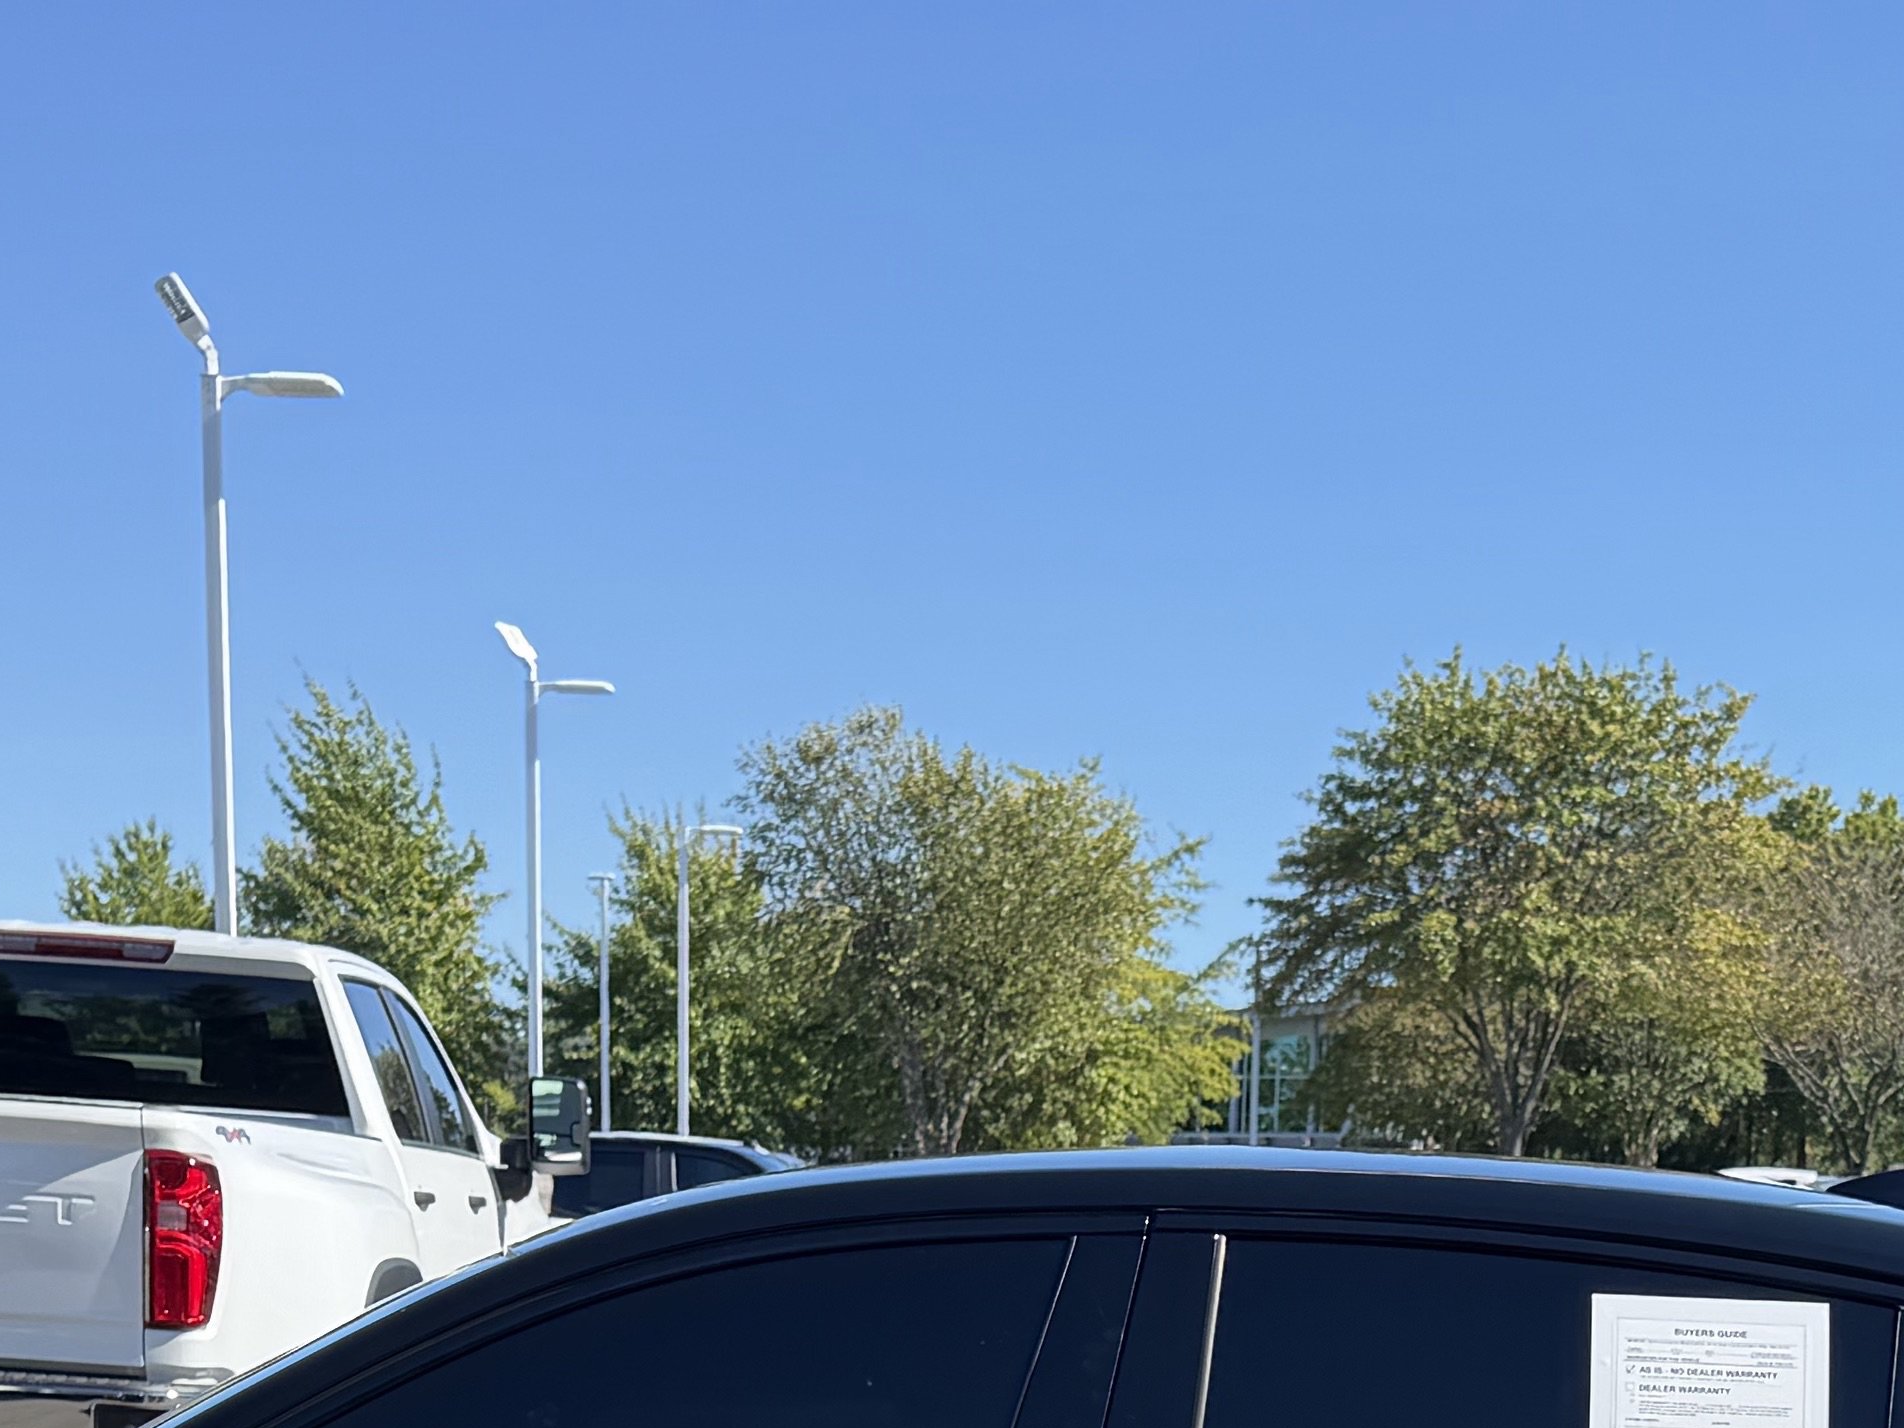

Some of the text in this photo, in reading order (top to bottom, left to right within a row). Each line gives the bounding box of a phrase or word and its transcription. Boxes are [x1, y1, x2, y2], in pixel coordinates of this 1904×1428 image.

[1674, 1328, 1748, 1339] BUYERS GUIDE
[1639, 1366, 1651, 1374] AS
[1686, 1368, 1724, 1377] DEALER
[1726, 1370, 1778, 1380] WARRANTY
[1638, 1384, 1732, 1395] DEALER WARRANTY
